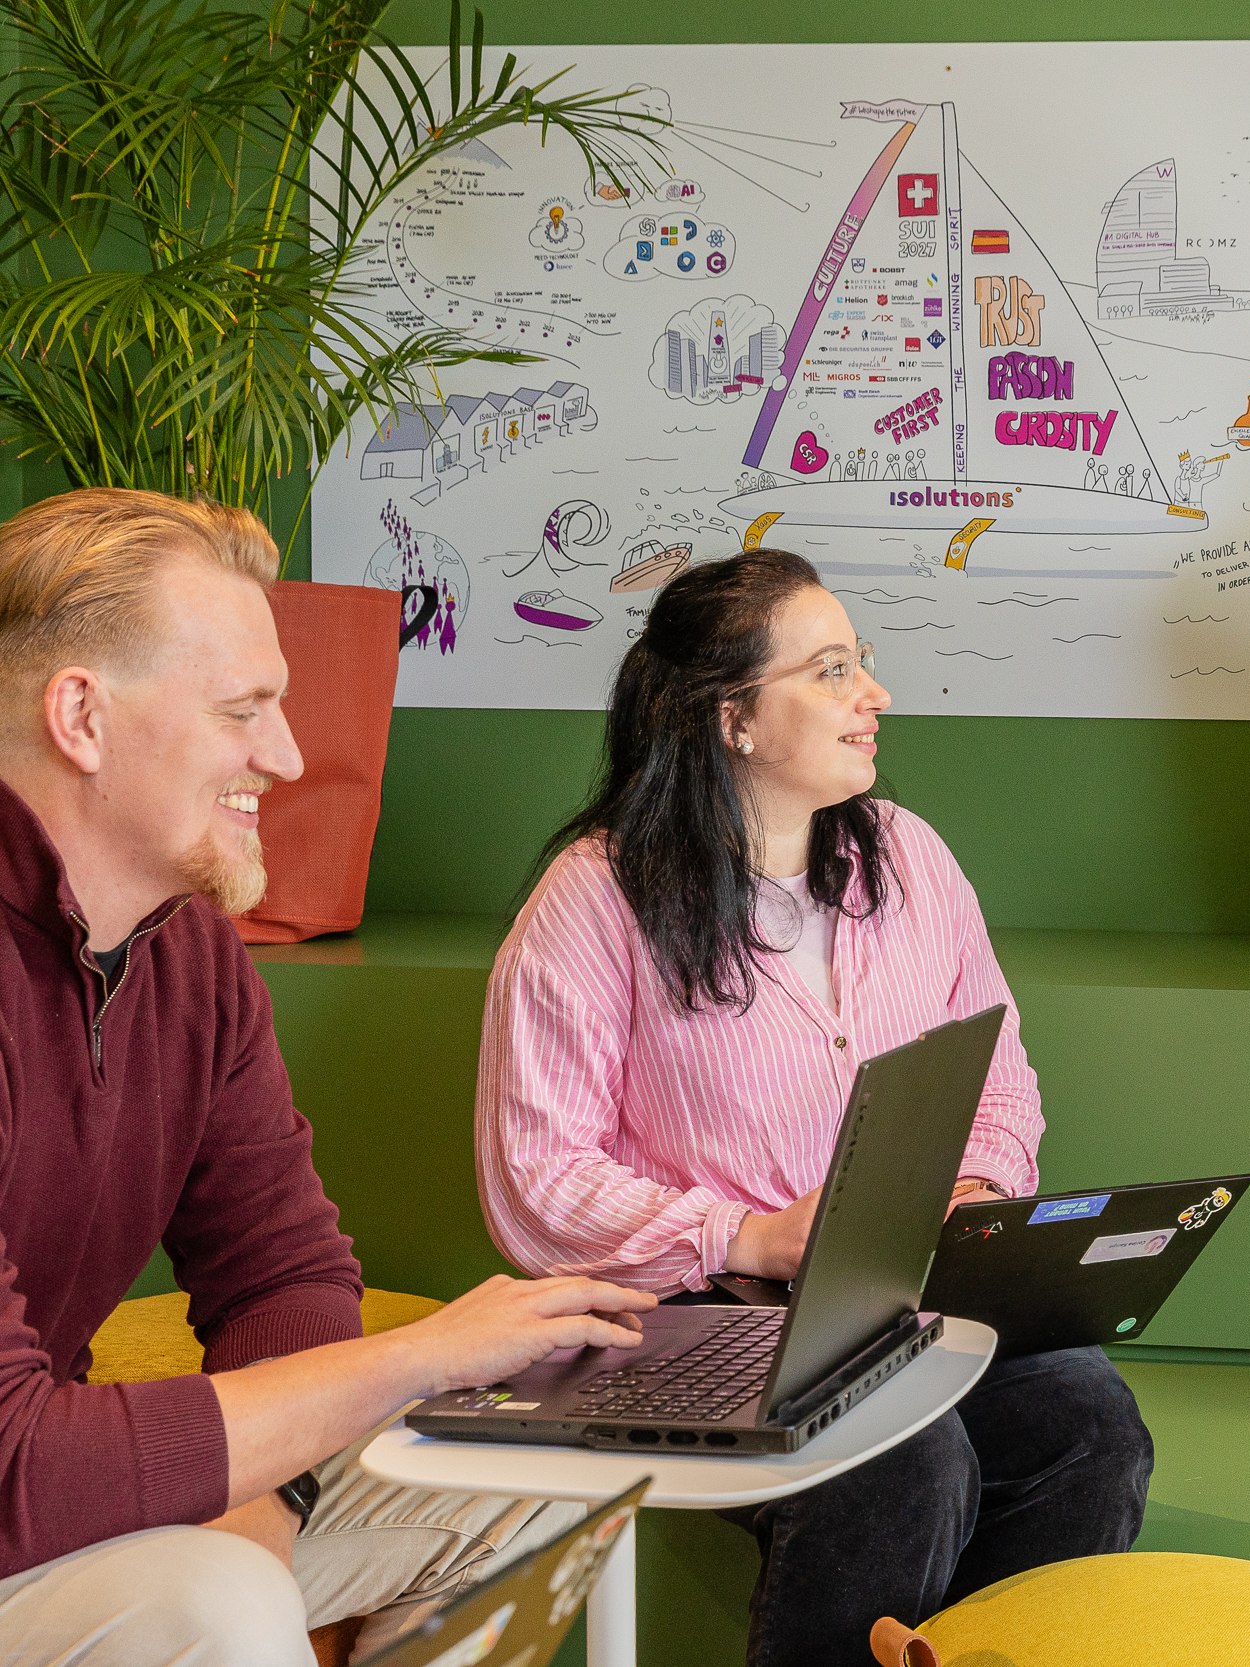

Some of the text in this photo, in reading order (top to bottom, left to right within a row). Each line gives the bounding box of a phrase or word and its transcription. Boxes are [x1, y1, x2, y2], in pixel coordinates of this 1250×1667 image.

[1156, 166, 1173, 178] W
[681, 185, 695, 197] AI
[538, 196, 575, 215] INNOVATION
[899, 220, 936, 240] SUI
[949, 207, 962, 251] SPIRIT
[1116, 232, 1142, 241] DIGITAL
[1147, 231, 1160, 240] HUB
[812, 212, 863, 303] CULTURE
[898, 241, 937, 258] 2027
[894, 278, 918, 288] amag
[844, 296, 868, 304] Helion
[951, 273, 961, 332] WINNING
[871, 314, 894, 322] SIX
[974, 276, 1046, 348] TRUST
[929, 336, 943, 344] LGT
[827, 373, 861, 381] MIGROS
[955, 367, 965, 392] THE
[988, 351, 1074, 401] PASSION
[874, 387, 943, 435] CUSTOMER
[892, 407, 939, 445] FIRST
[995, 409, 1119, 456] CURIOSITY
[799, 443, 817, 466] CSR
[956, 423, 966, 474] KEEPING
[1168, 506, 1205, 518] CONSULTING
[959, 520, 983, 541] SECURITY
[1201, 541, 1237, 562] PROVIDE
[1202, 571, 1212, 579] TO
[1216, 561, 1250, 576] DELIVER
[1218, 582, 1226, 592] IN
